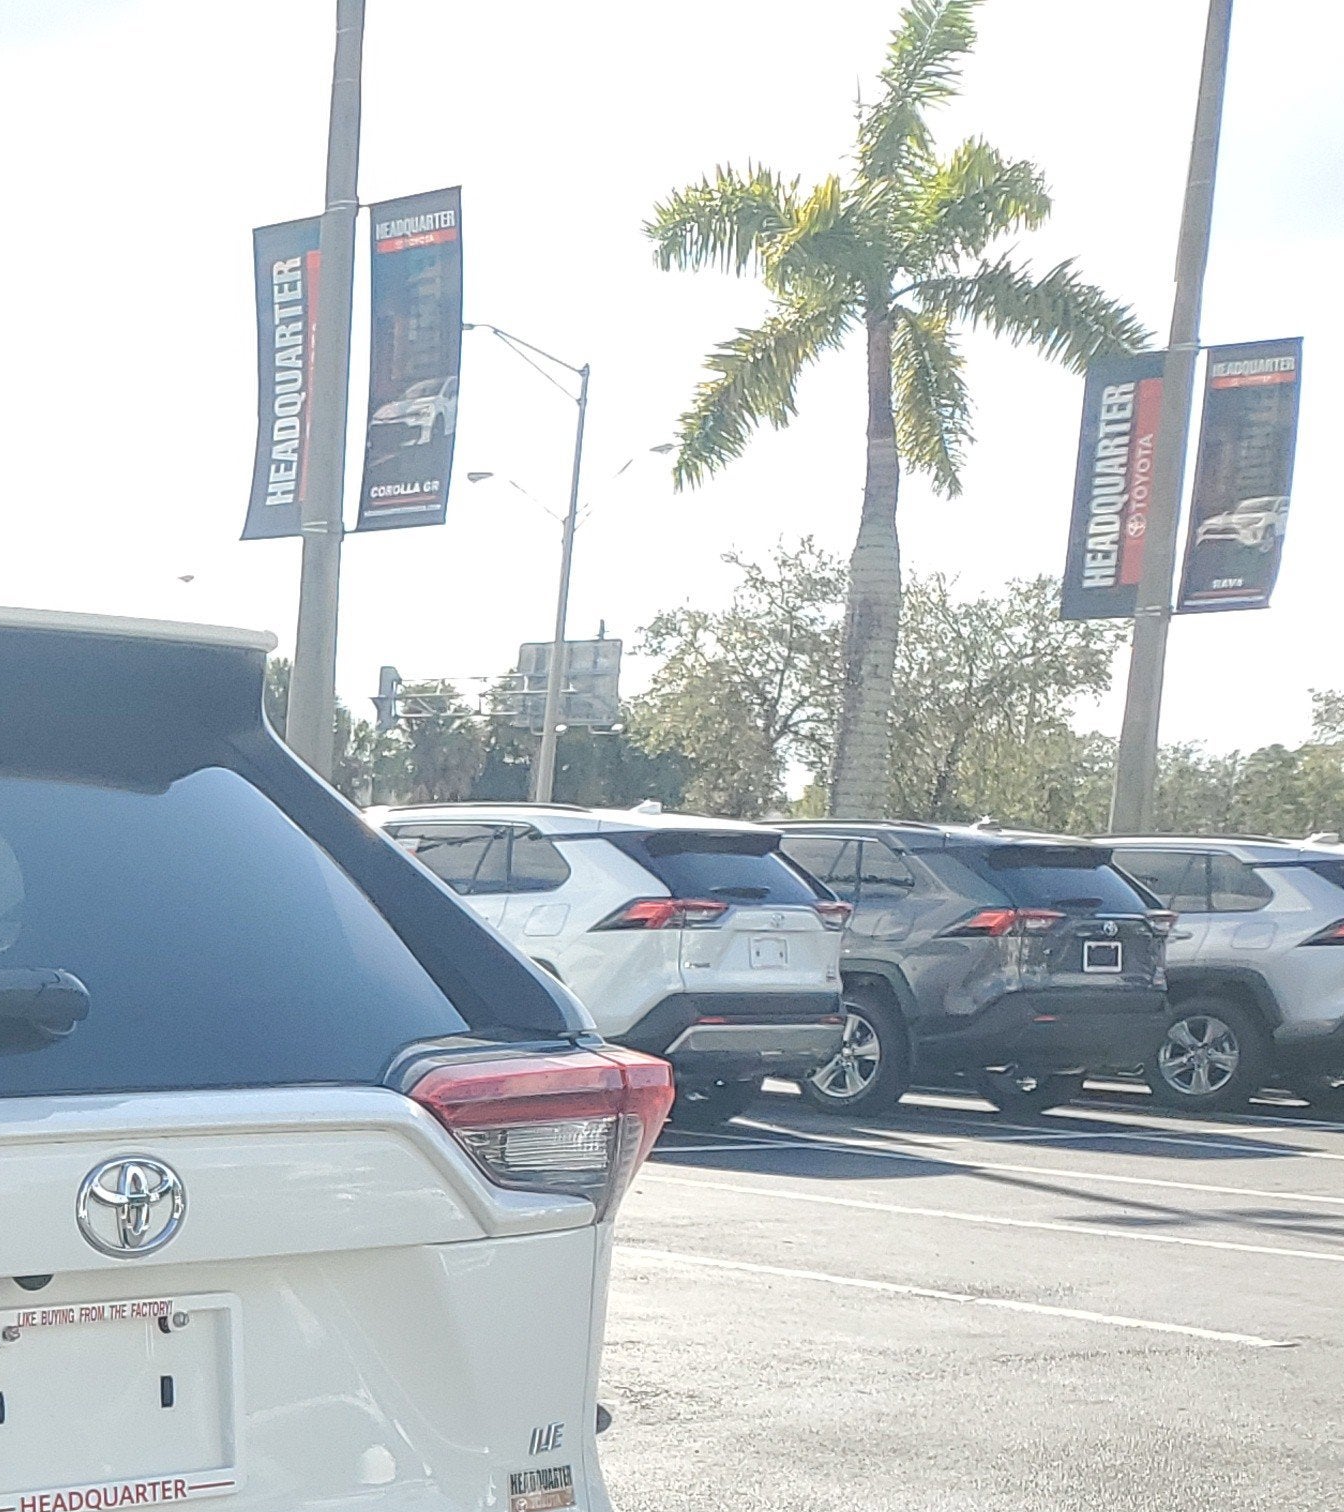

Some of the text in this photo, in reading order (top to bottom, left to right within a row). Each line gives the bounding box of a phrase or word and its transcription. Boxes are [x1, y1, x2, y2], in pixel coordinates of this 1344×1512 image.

[376, 210, 455, 240] HEADQUARTER
[265, 256, 306, 506] HEADQUARTER
[1213, 356, 1295, 377] HEADQUARTER
[1082, 381, 1136, 588] HEADQUARTER
[1131, 433, 1154, 513] TOYOTA
[370, 480, 440, 498] COROLLA GR
[17, 1300, 174, 1327] LIKE BUYING FROM THE FACTORY!
[510, 1464, 572, 1496] HEADQUARTER
